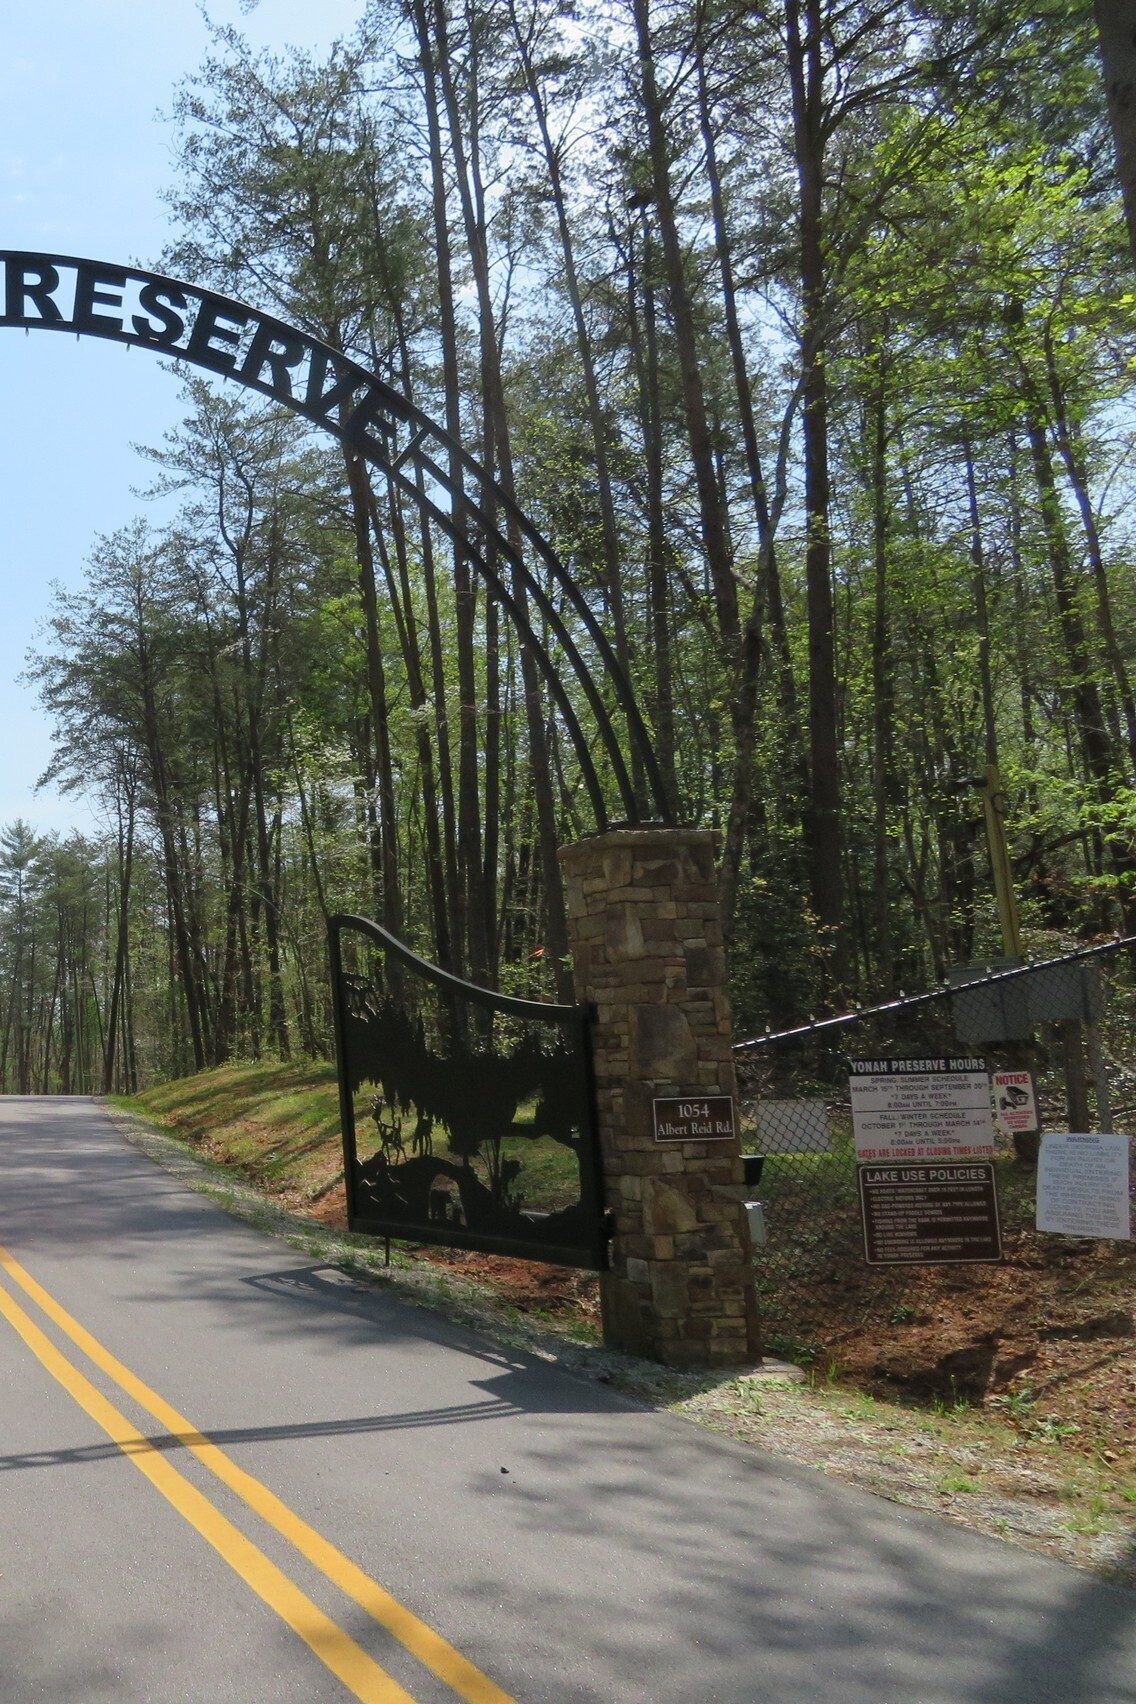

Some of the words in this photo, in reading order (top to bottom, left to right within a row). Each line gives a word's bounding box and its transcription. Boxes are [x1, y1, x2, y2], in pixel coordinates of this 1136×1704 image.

[850, 1060, 888, 1073] YONAH
[891, 1059, 946, 1072] PRESERVE
[949, 1058, 985, 1071] HOURS
[932, 1075, 968, 1083] SCHEDULE
[995, 1073, 1029, 1086] NOTICE
[930, 1082, 971, 1091] SEPTEMBER
[678, 1103, 710, 1118] 1054
[658, 1122, 688, 1136] Albert
[691, 1121, 712, 1134] Reid
[716, 1120, 733, 1133] Rd.
[861, 1122, 896, 1130] OCTOBER
[909, 1120, 944, 1128] THROUGH
[866, 1171, 898, 1182] LAKE
[901, 1170, 926, 1181] USE
[929, 1168, 986, 1180] POLICIES
